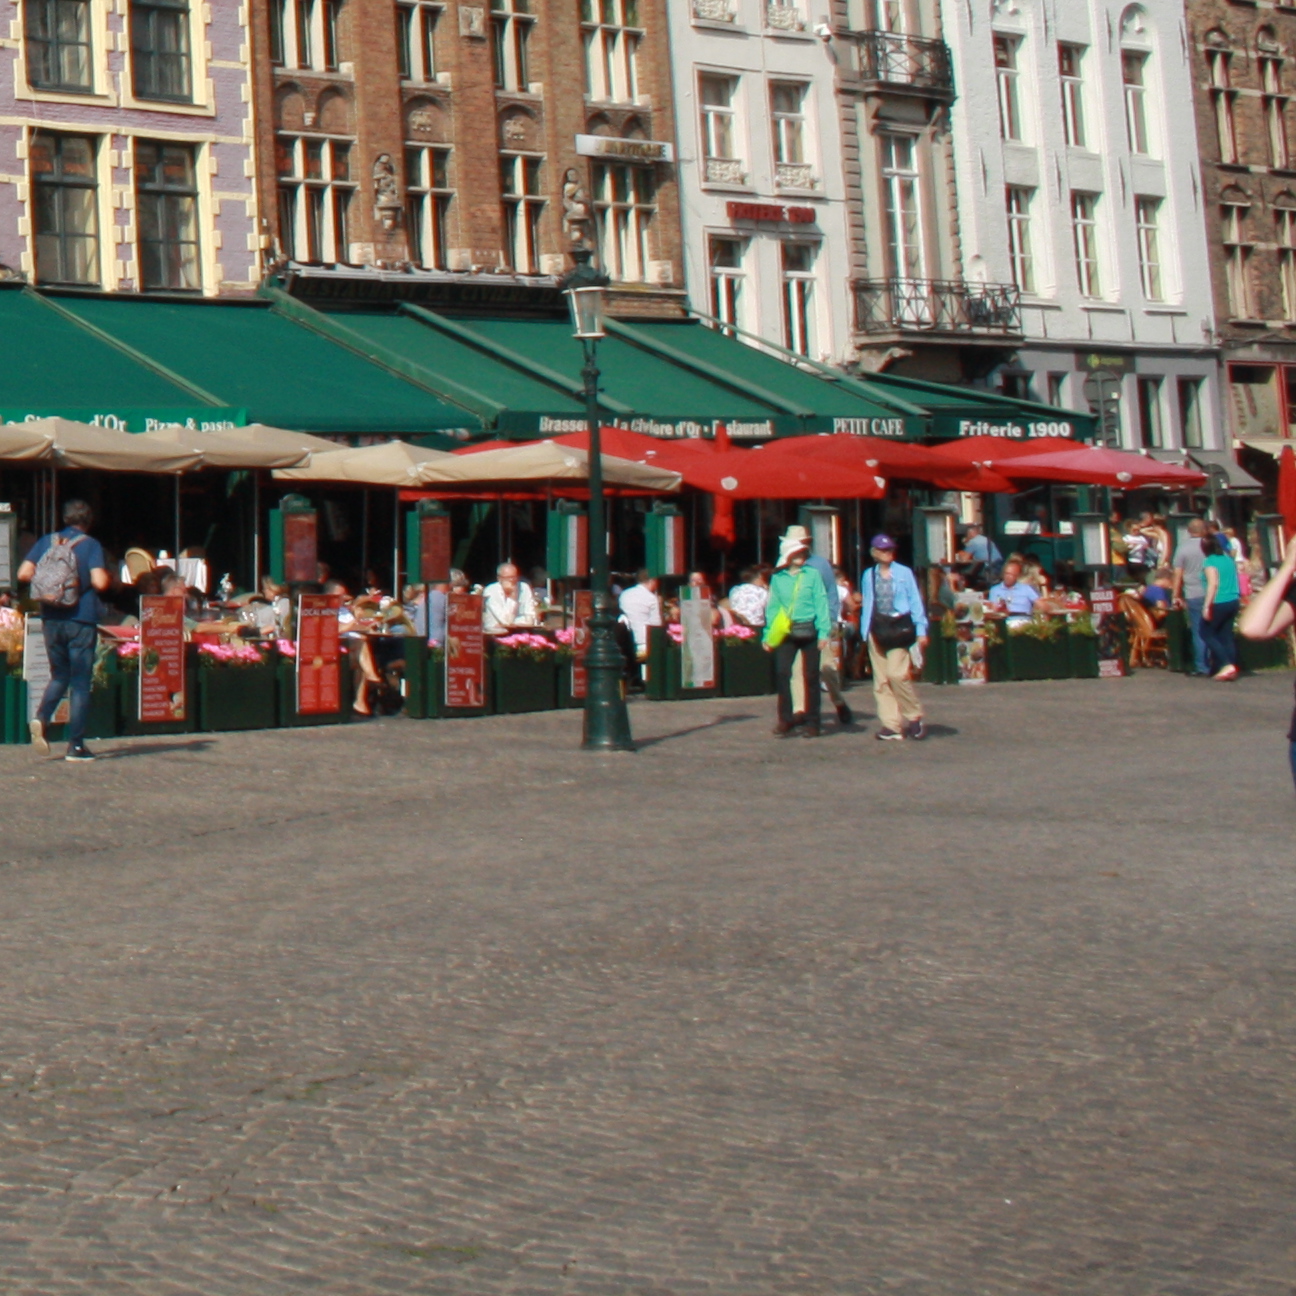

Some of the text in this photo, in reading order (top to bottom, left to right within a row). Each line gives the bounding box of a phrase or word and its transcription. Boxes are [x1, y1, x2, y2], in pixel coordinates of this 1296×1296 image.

[832, 417, 904, 436] PETIT CAFE
[959, 420, 1071, 438] Friterie 1900
